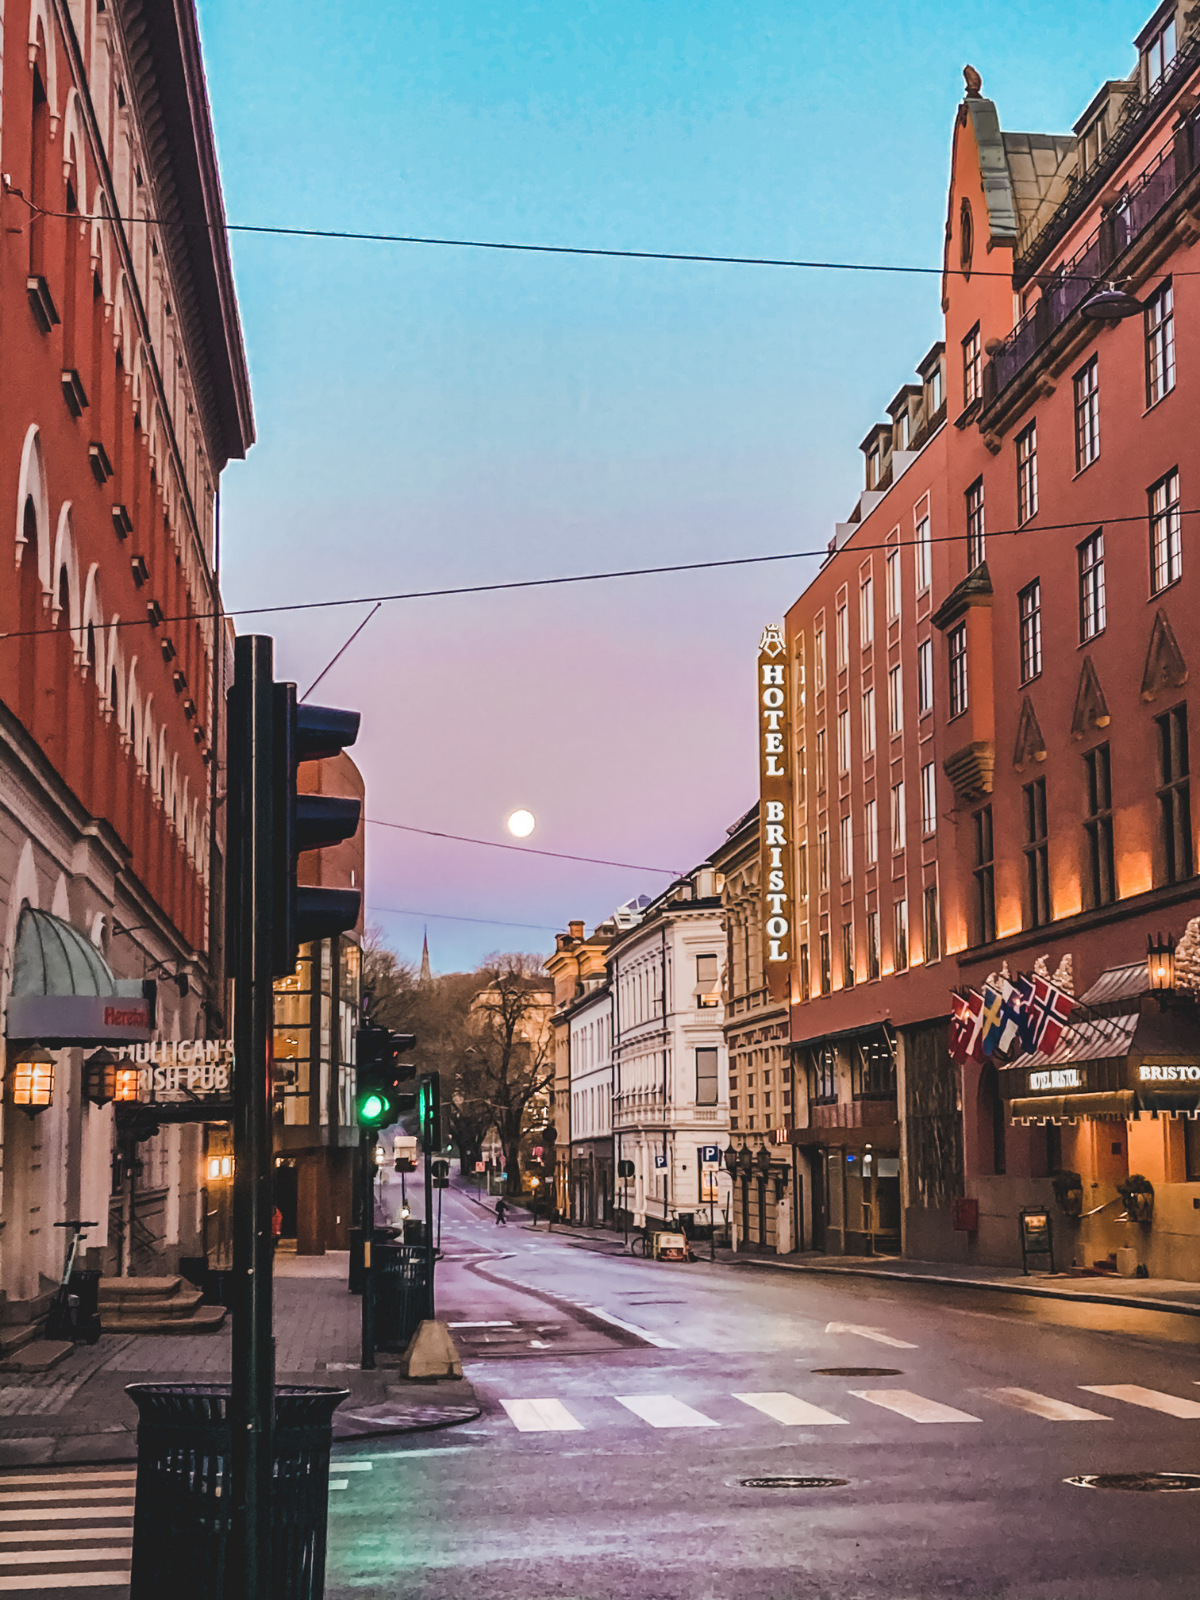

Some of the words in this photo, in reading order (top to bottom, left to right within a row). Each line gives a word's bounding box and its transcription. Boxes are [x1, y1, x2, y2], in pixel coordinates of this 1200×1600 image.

[762, 665, 785, 776] HOTEL
[765, 801, 788, 961] BRISTOL
[118, 1040, 235, 1064] MULLIGAN'S
[139, 1067, 180, 1091] RISH
[187, 1066, 229, 1090] PUB
[1139, 1065, 1200, 1081] BRISTO
[656, 1156, 665, 1168] P
[705, 1147, 715, 1161] P
